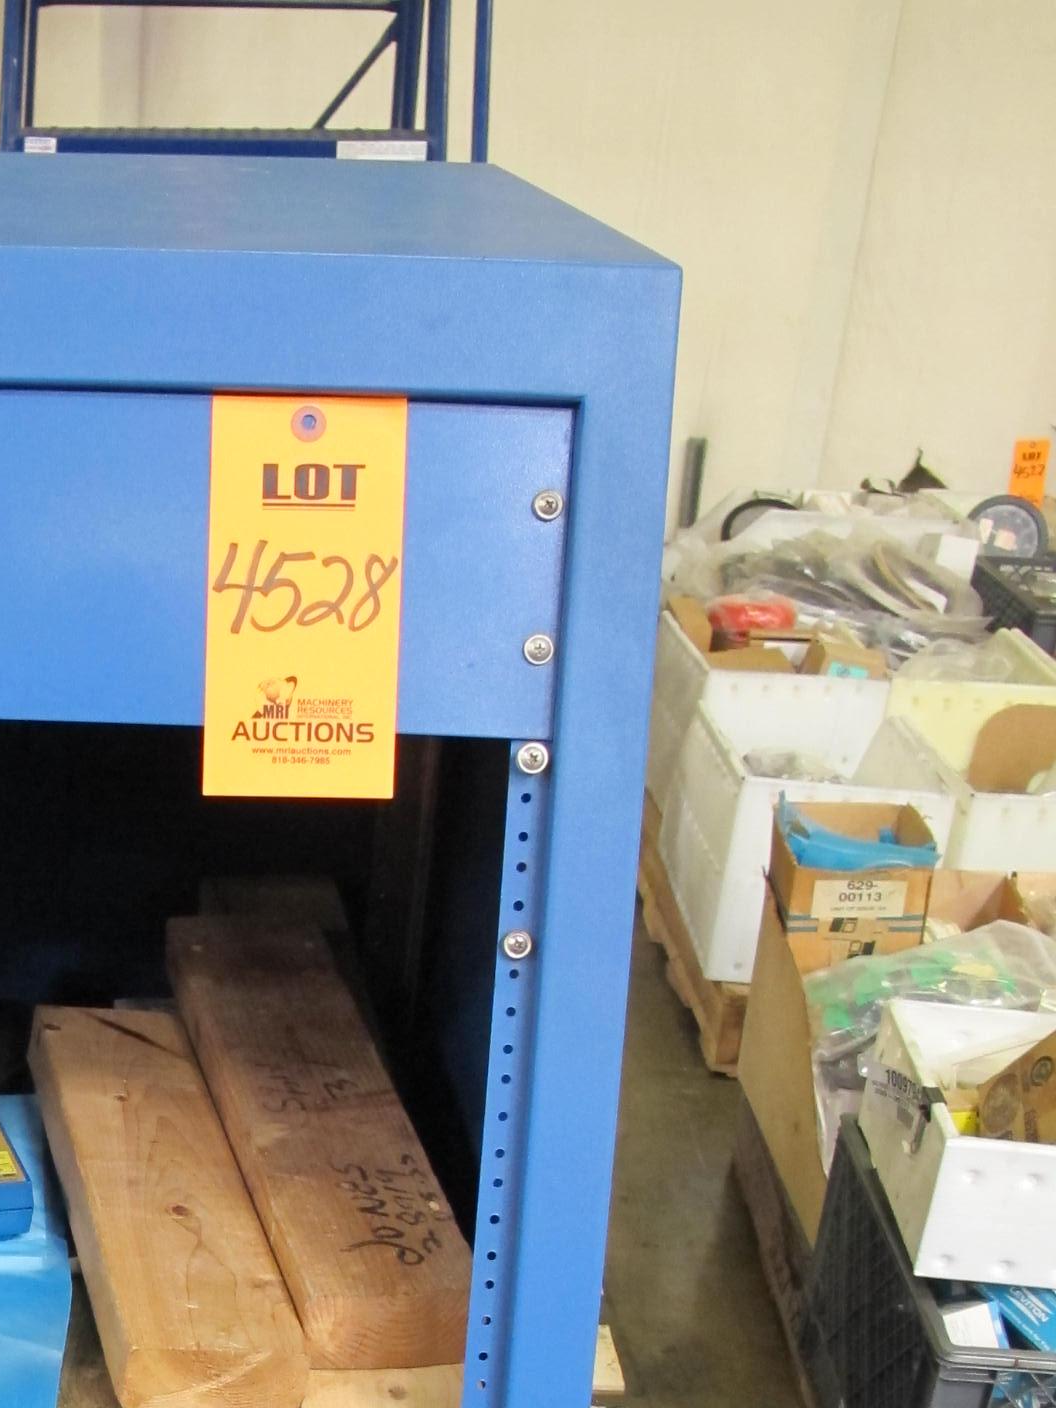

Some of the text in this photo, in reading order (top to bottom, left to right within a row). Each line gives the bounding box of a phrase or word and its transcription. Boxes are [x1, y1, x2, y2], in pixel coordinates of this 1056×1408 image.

[262, 463, 366, 501] LOT
[212, 539, 399, 635] 4528
[297, 698, 354, 708] MACHINERY
[297, 706, 353, 715] RESOURCES
[231, 721, 375, 743] AUCTIONS
[847, 880, 879, 891] 629-
[839, 892, 882, 902] 00113
